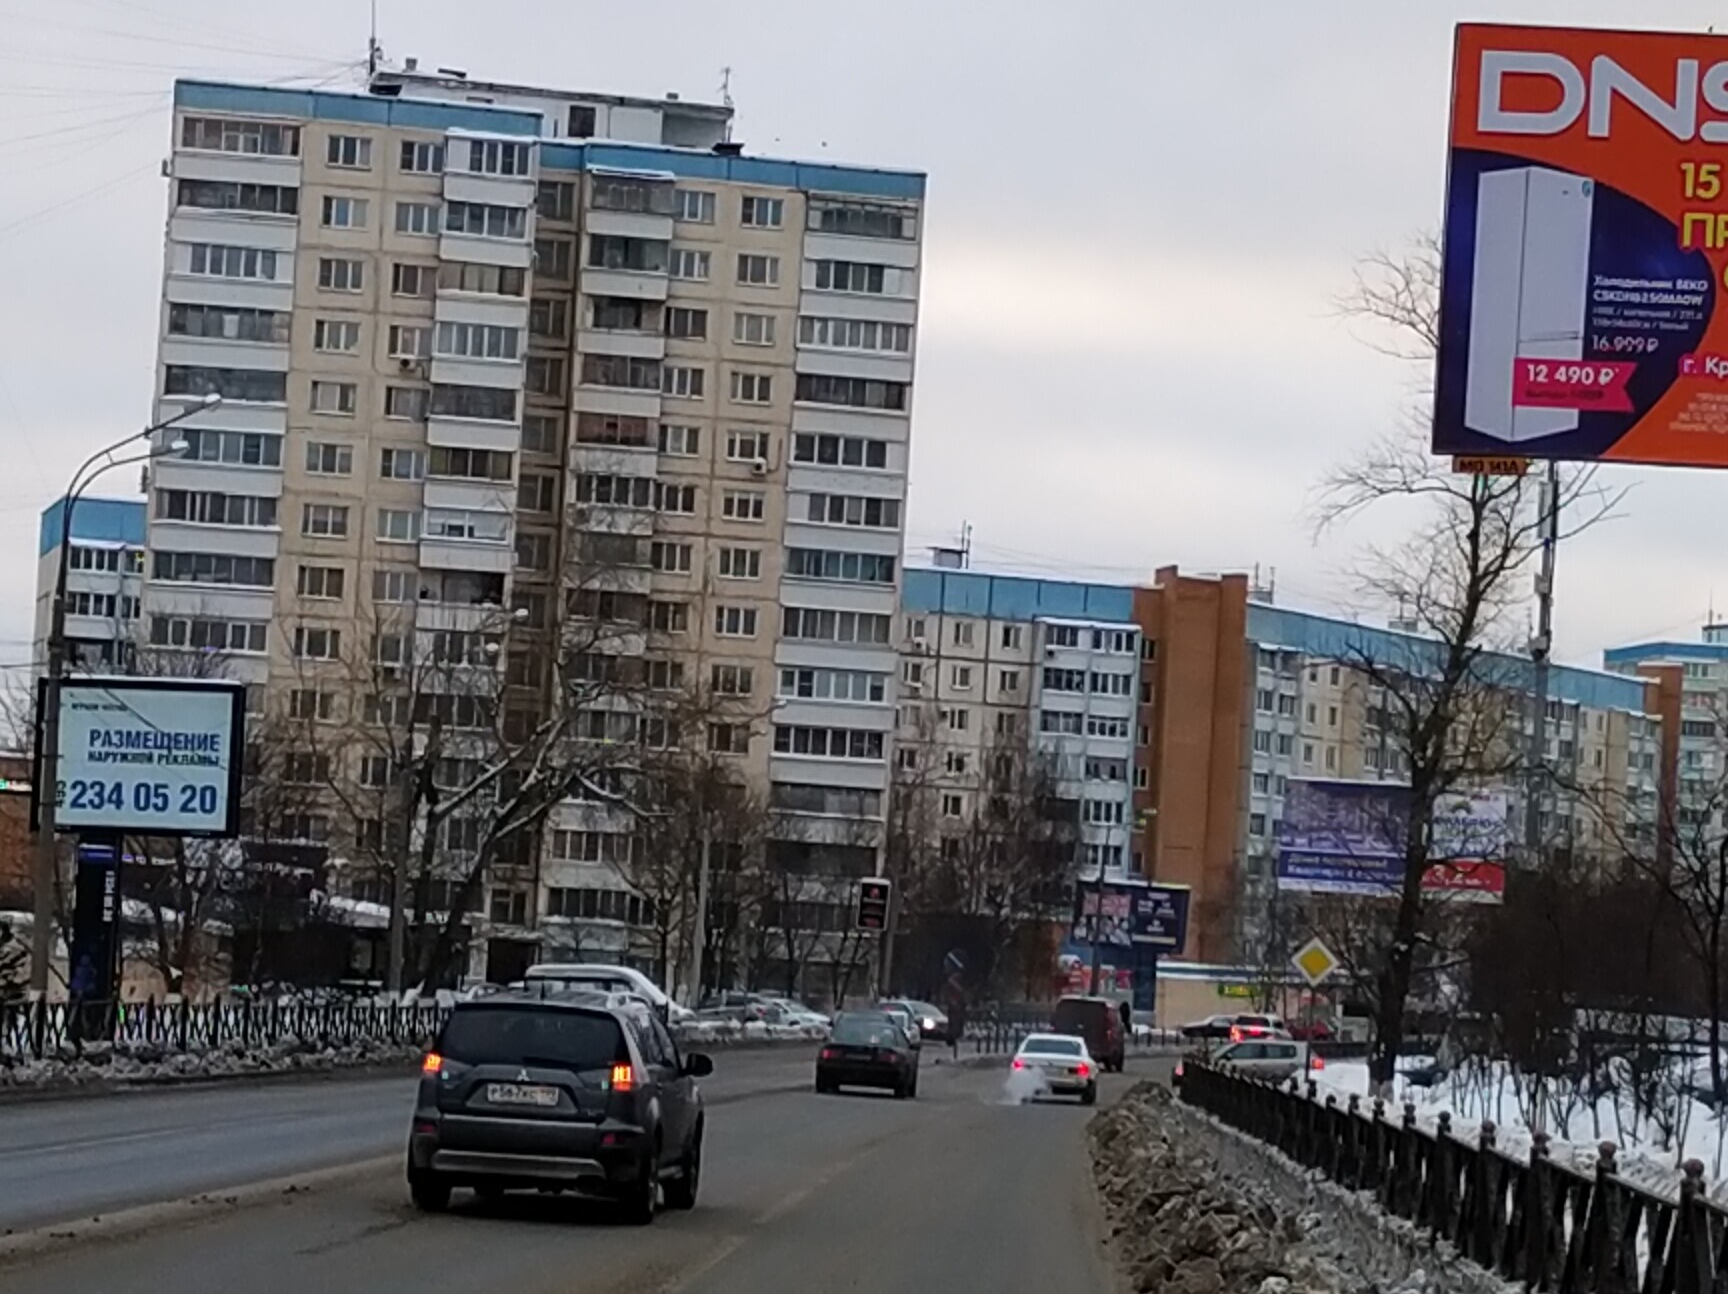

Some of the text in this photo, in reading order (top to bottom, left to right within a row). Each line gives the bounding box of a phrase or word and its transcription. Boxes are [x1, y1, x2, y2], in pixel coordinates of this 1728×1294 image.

[1680, 162, 1722, 200] 15
[1592, 334, 1609, 350] 16
[1527, 364, 1549, 383] 12
[1554, 365, 1594, 385] 490
[89, 728, 221, 754] РАЗМЕЩЕНИЕ
[88, 751, 219, 767] НАРУЖНОЙ РЕКЛАМЫ
[70, 780, 124, 810] 234
[133, 781, 170, 811] 05
[179, 784, 217, 814] 20
